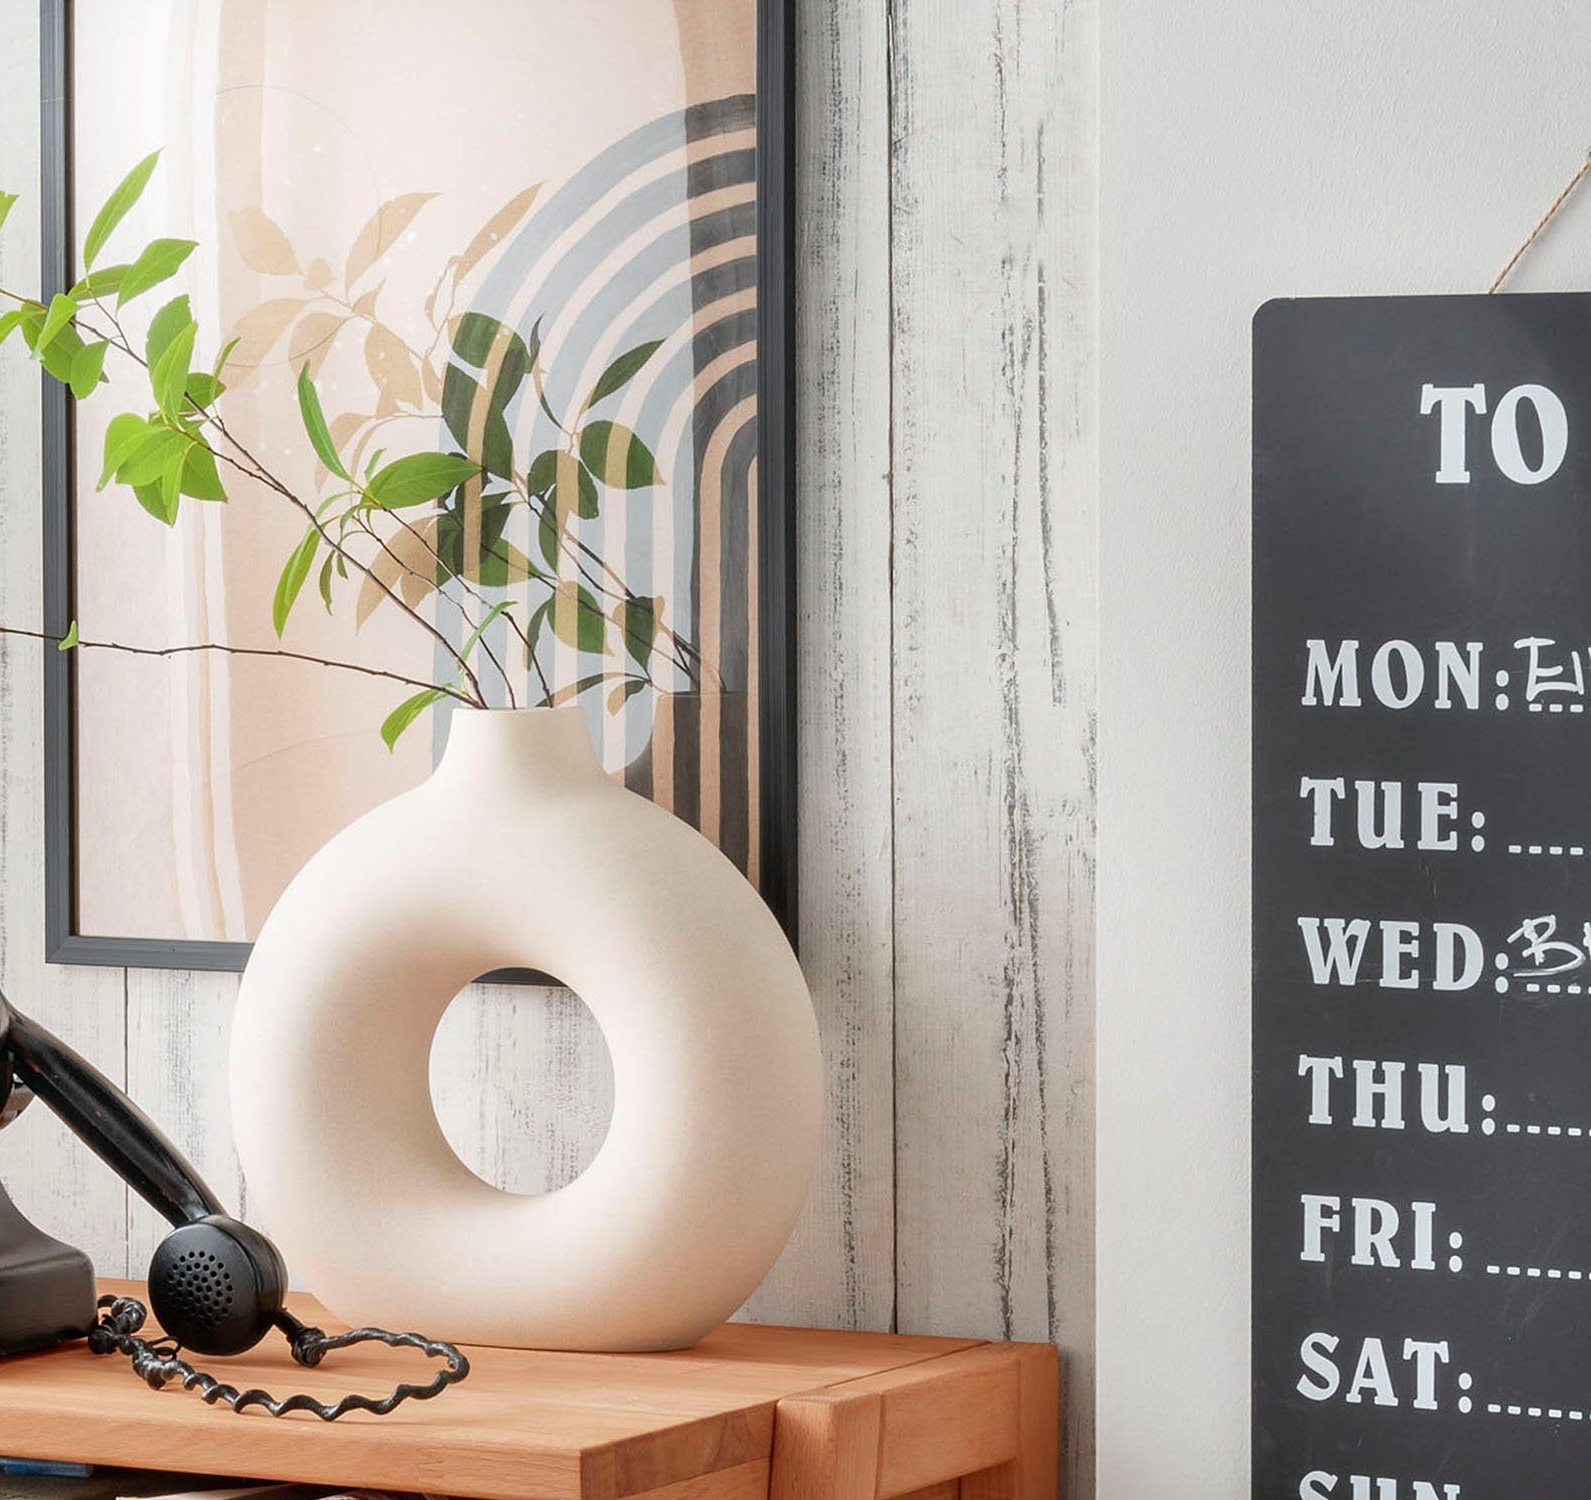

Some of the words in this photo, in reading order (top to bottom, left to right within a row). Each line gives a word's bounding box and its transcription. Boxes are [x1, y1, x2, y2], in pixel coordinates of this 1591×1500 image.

[1420, 384, 1568, 484] TO
[1302, 639, 1509, 711] MON:
[1300, 777, 1485, 852] TUE:
[1297, 917, 1508, 993] WED:
[1298, 1054, 1496, 1136] THU:
[1300, 1193, 1463, 1273] FRI:
[1296, 1332, 1473, 1413] SAT:
